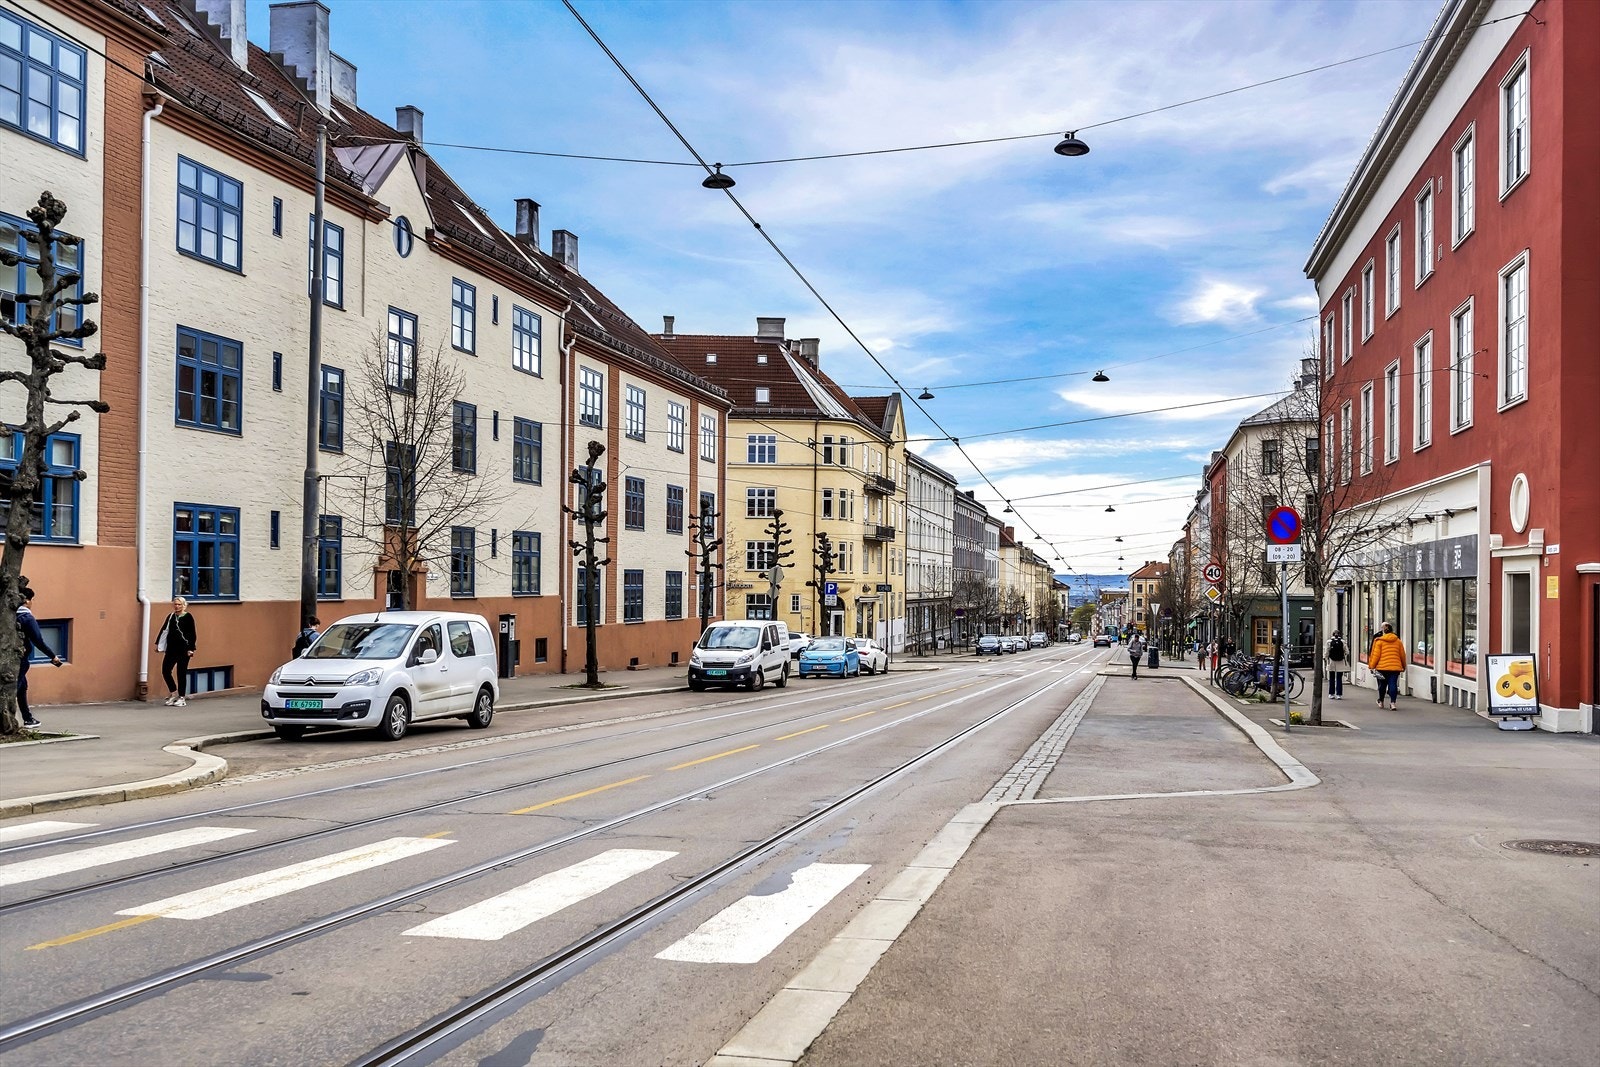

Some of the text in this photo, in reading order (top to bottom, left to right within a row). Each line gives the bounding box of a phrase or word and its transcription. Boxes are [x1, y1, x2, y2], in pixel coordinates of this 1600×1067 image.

[1207, 568, 1221, 578] 40
[828, 583, 835, 593] P
[501, 623, 507, 631] P
